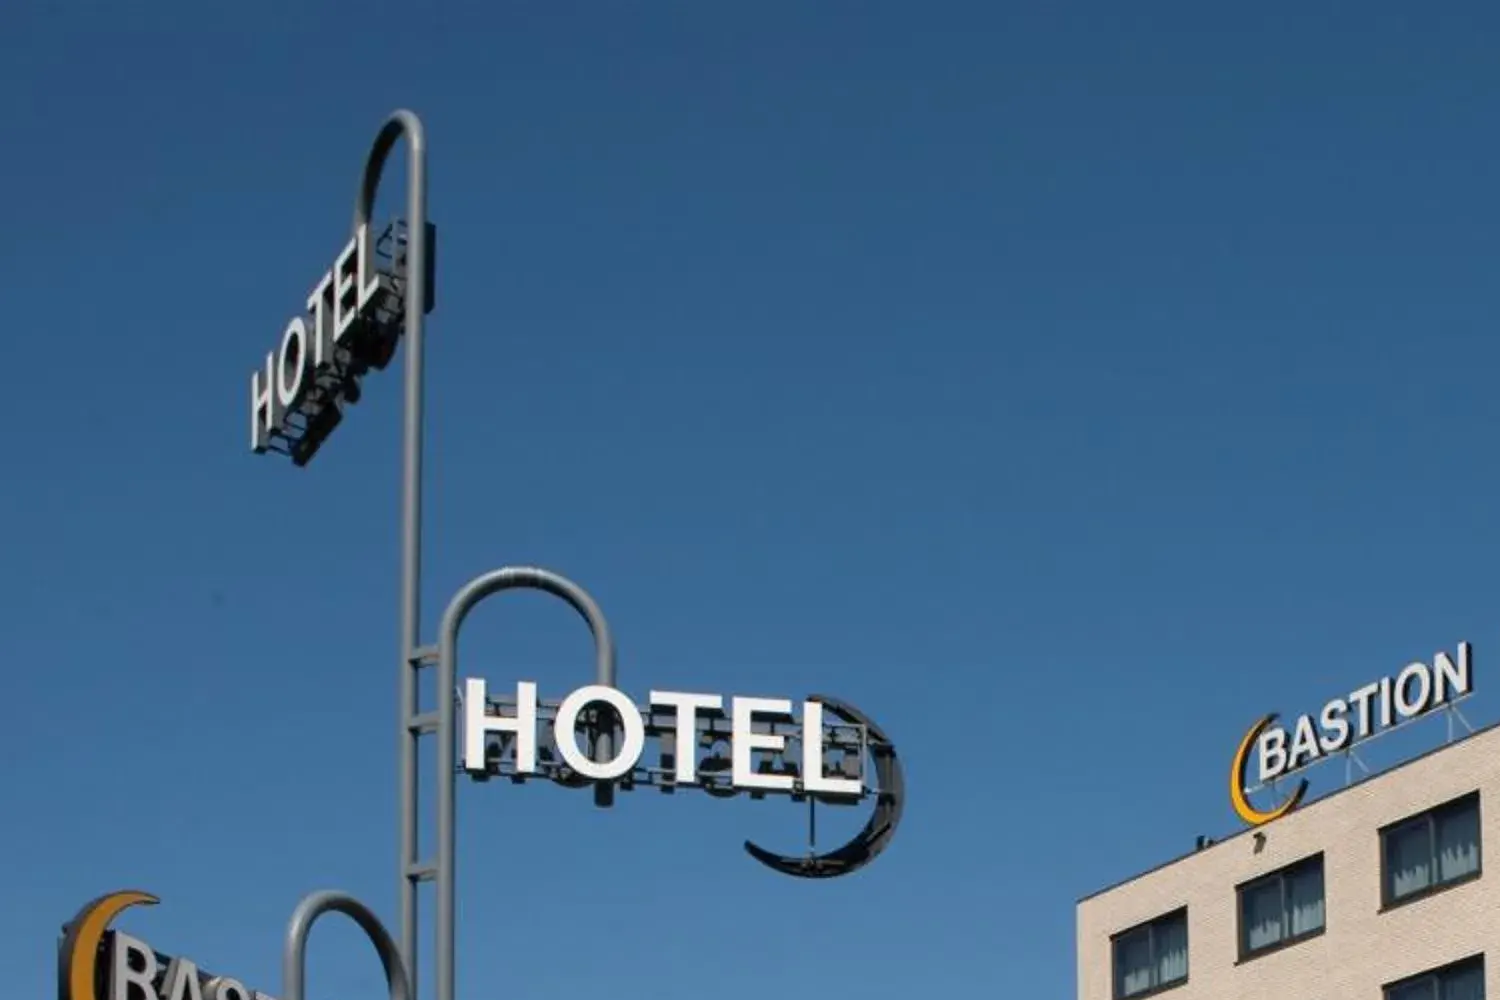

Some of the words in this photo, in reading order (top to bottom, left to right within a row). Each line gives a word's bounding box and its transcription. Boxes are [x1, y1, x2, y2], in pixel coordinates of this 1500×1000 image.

[251, 224, 380, 450] HOTEL
[465, 677, 863, 794] HOTEL
[1259, 641, 1473, 782] BASTION
